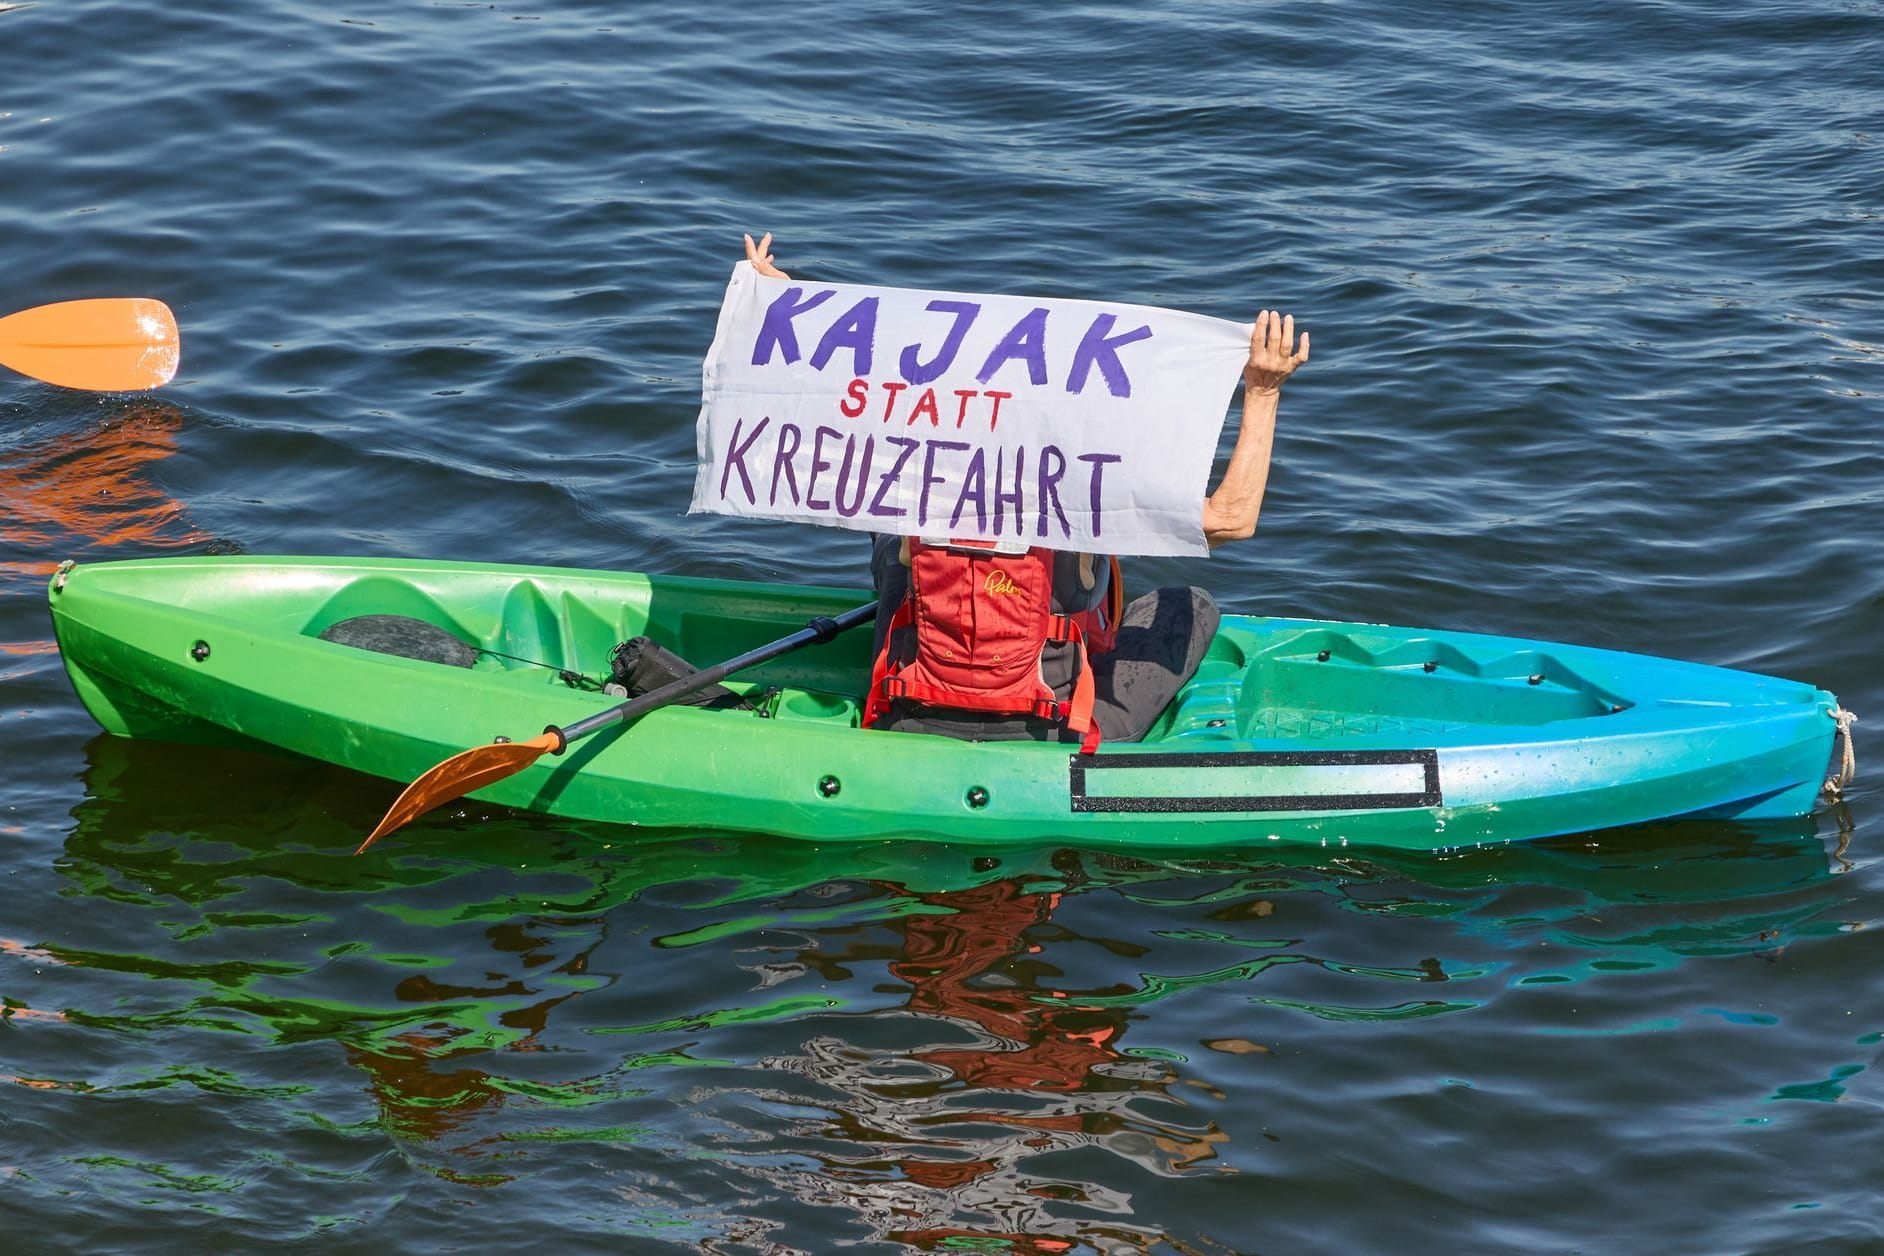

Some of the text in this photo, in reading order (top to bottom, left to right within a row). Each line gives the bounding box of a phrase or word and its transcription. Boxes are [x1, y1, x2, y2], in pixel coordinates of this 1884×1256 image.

[751, 287, 1153, 398] KAJAK
[840, 378, 1013, 432] STATT
[720, 416, 1122, 540] KREUZFAHRT
[984, 569, 1023, 597] Palm
